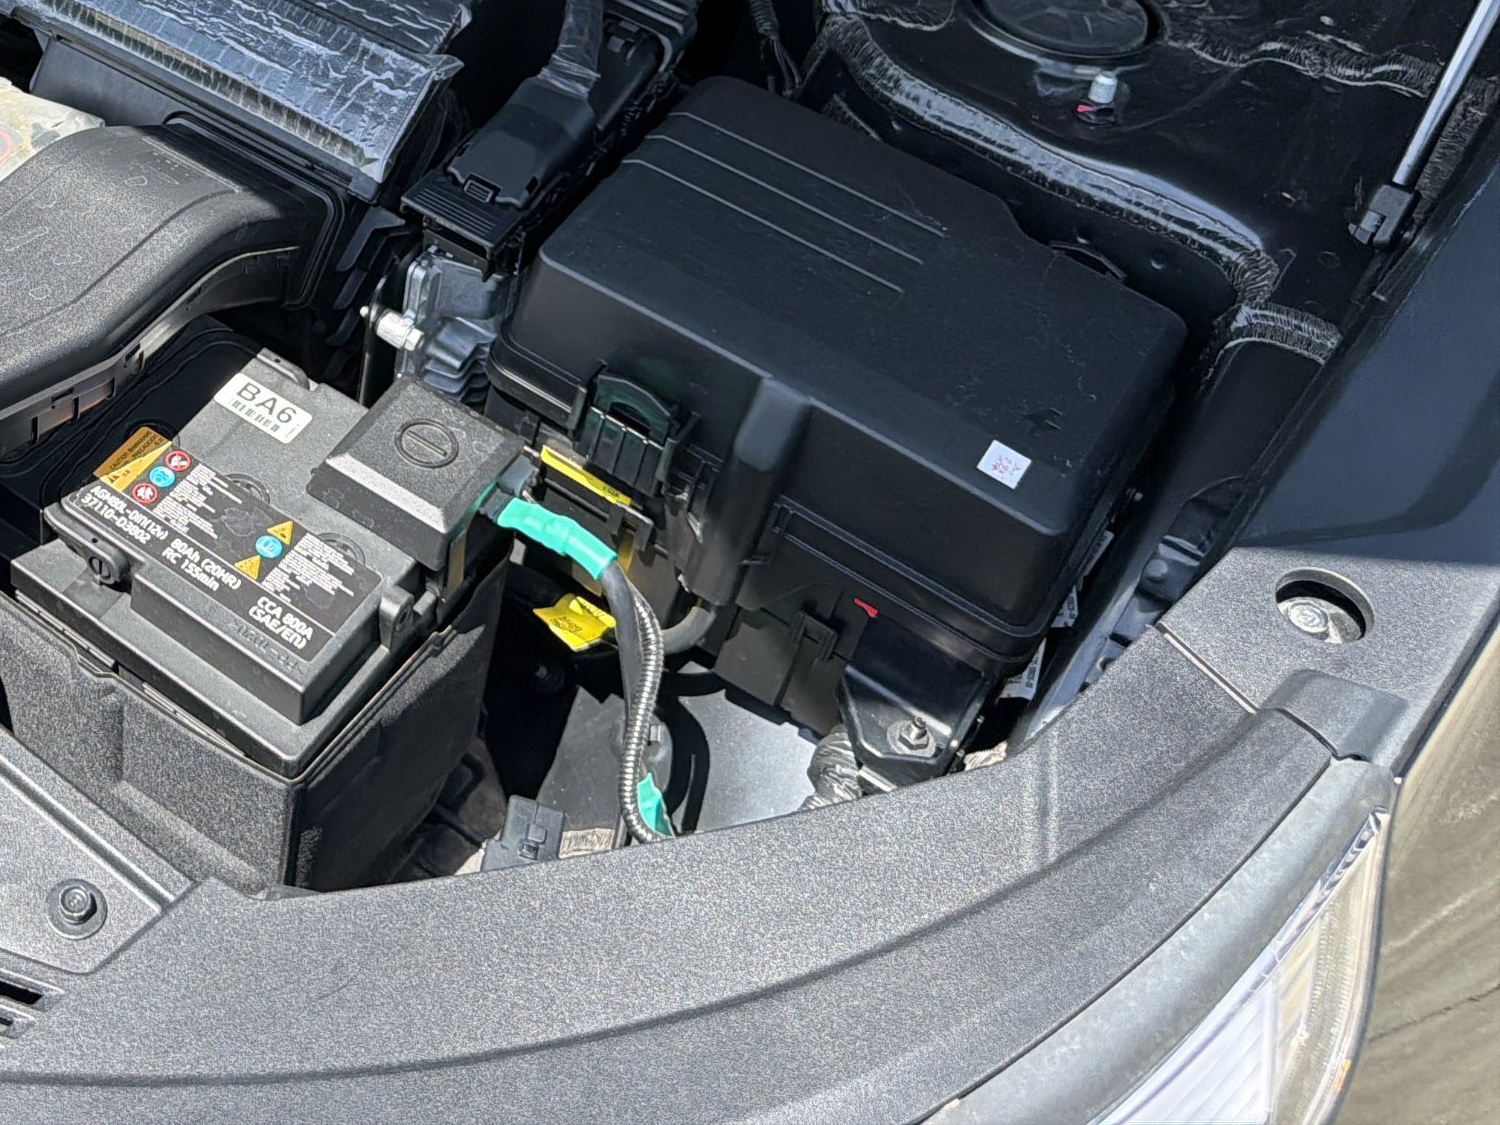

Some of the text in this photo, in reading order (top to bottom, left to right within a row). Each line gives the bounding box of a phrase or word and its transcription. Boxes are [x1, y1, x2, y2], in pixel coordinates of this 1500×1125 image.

[236, 382, 297, 425] BA6
[80, 493, 151, 544] 37110-D3802
[161, 546, 182, 565] RC
[180, 558, 220, 591] 155min
[170, 538, 200, 563] 80Ah
[200, 558, 242, 590] (20HR)
[257, 596, 314, 640] CCA 800A
